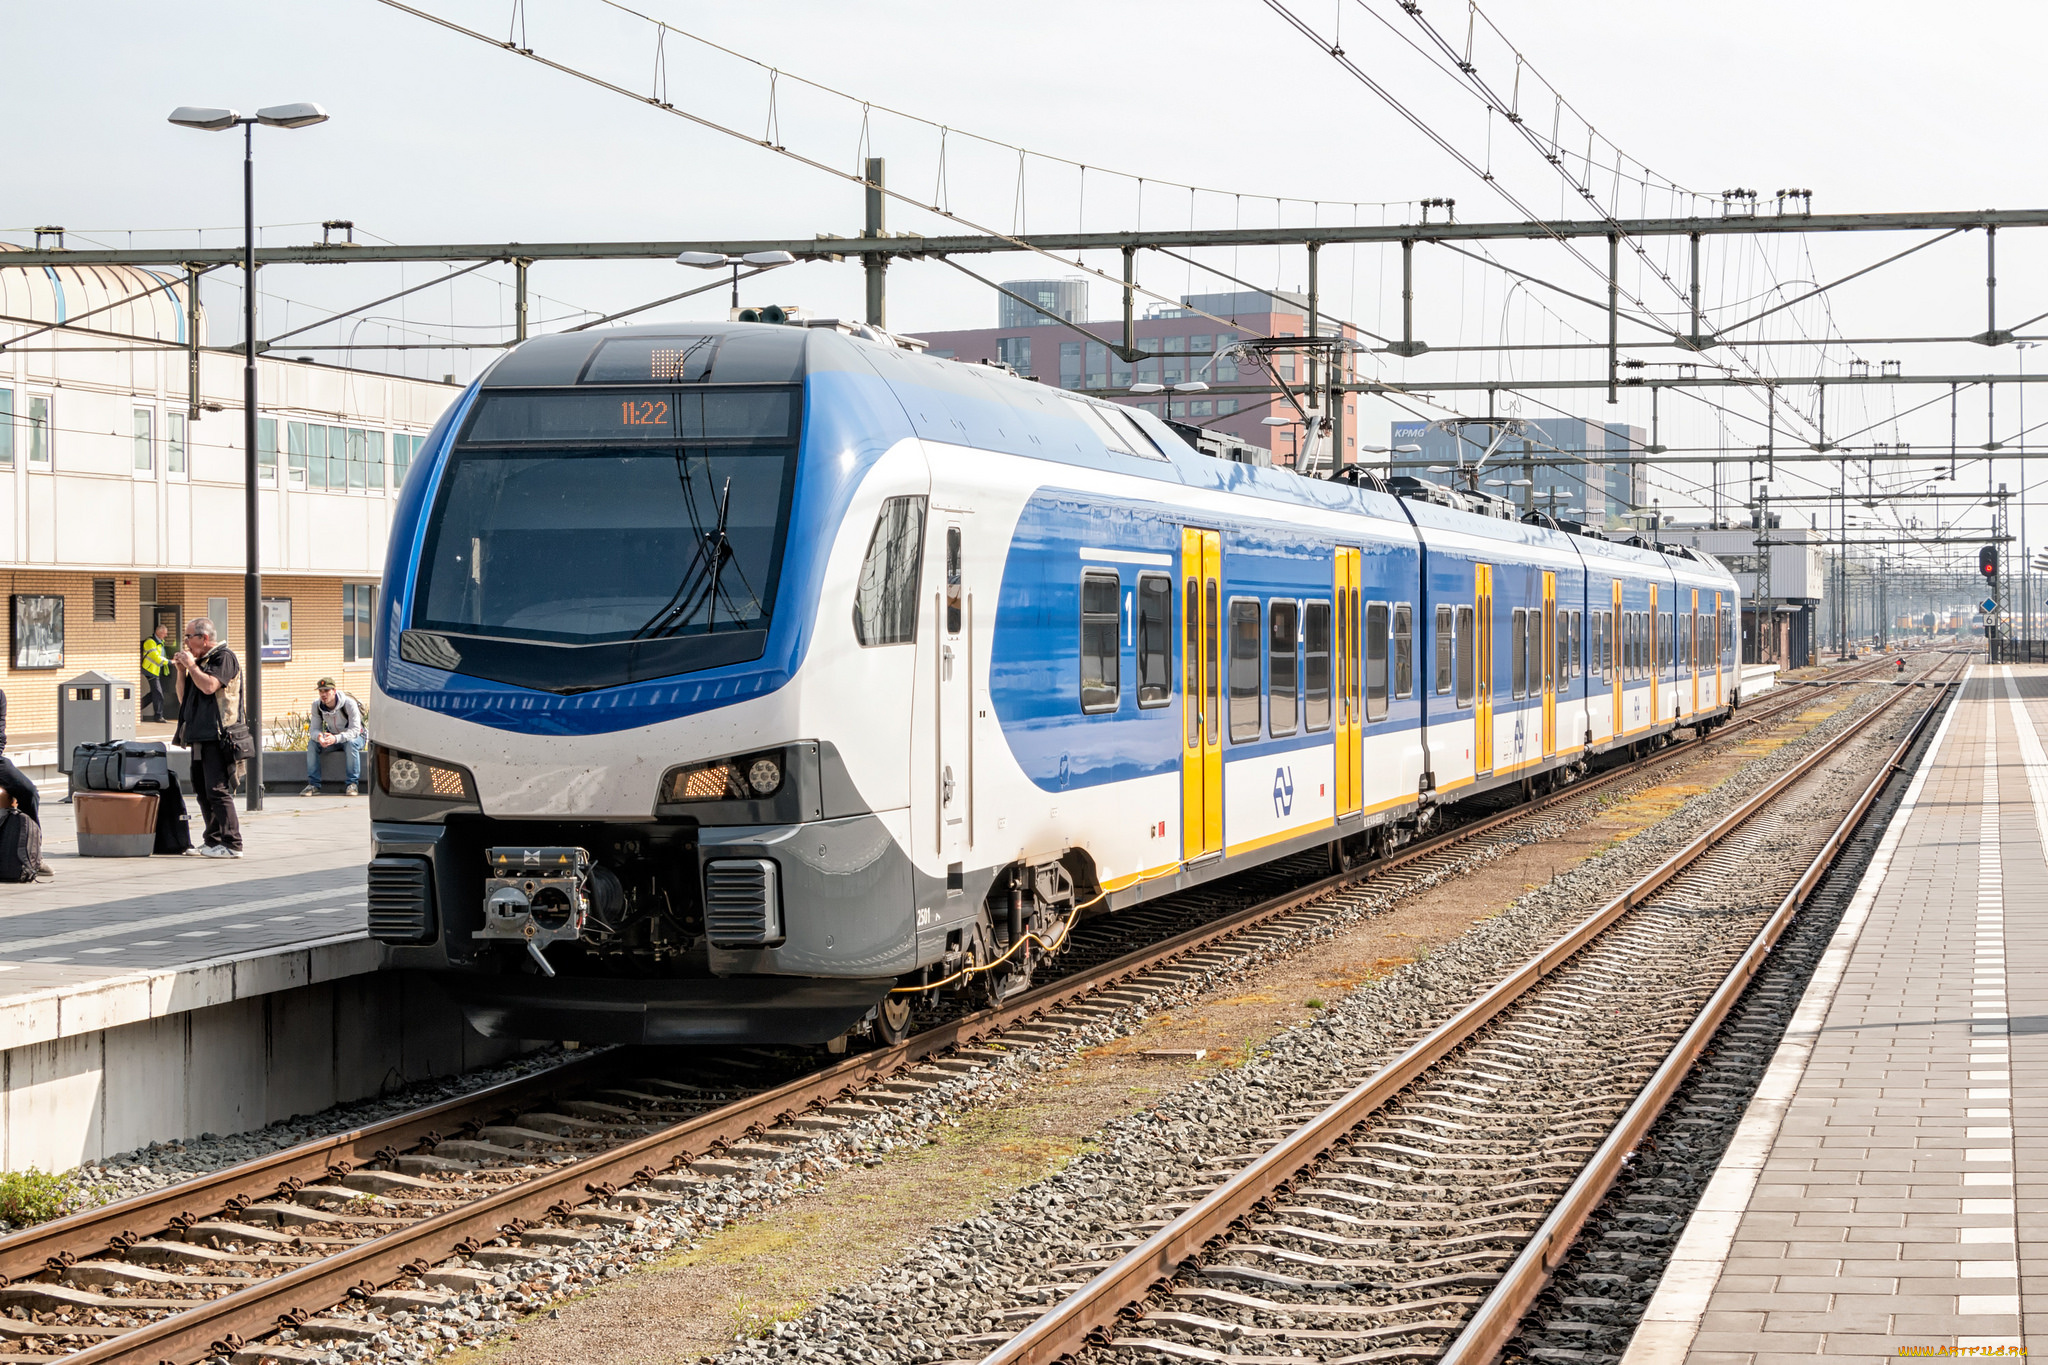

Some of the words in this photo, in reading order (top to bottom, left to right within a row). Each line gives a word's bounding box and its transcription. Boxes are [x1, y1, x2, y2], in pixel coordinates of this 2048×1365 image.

[621, 401, 668, 425] 11:22
[1394, 428, 1425, 438] KPMG
[1125, 591, 1132, 647] 1
[1297, 598, 1304, 643] 2
[1388, 600, 1394, 639] 2
[1451, 604, 1456, 639] 2
[1986, 615, 1993, 625] 6
[917, 907, 931, 926] 2501
